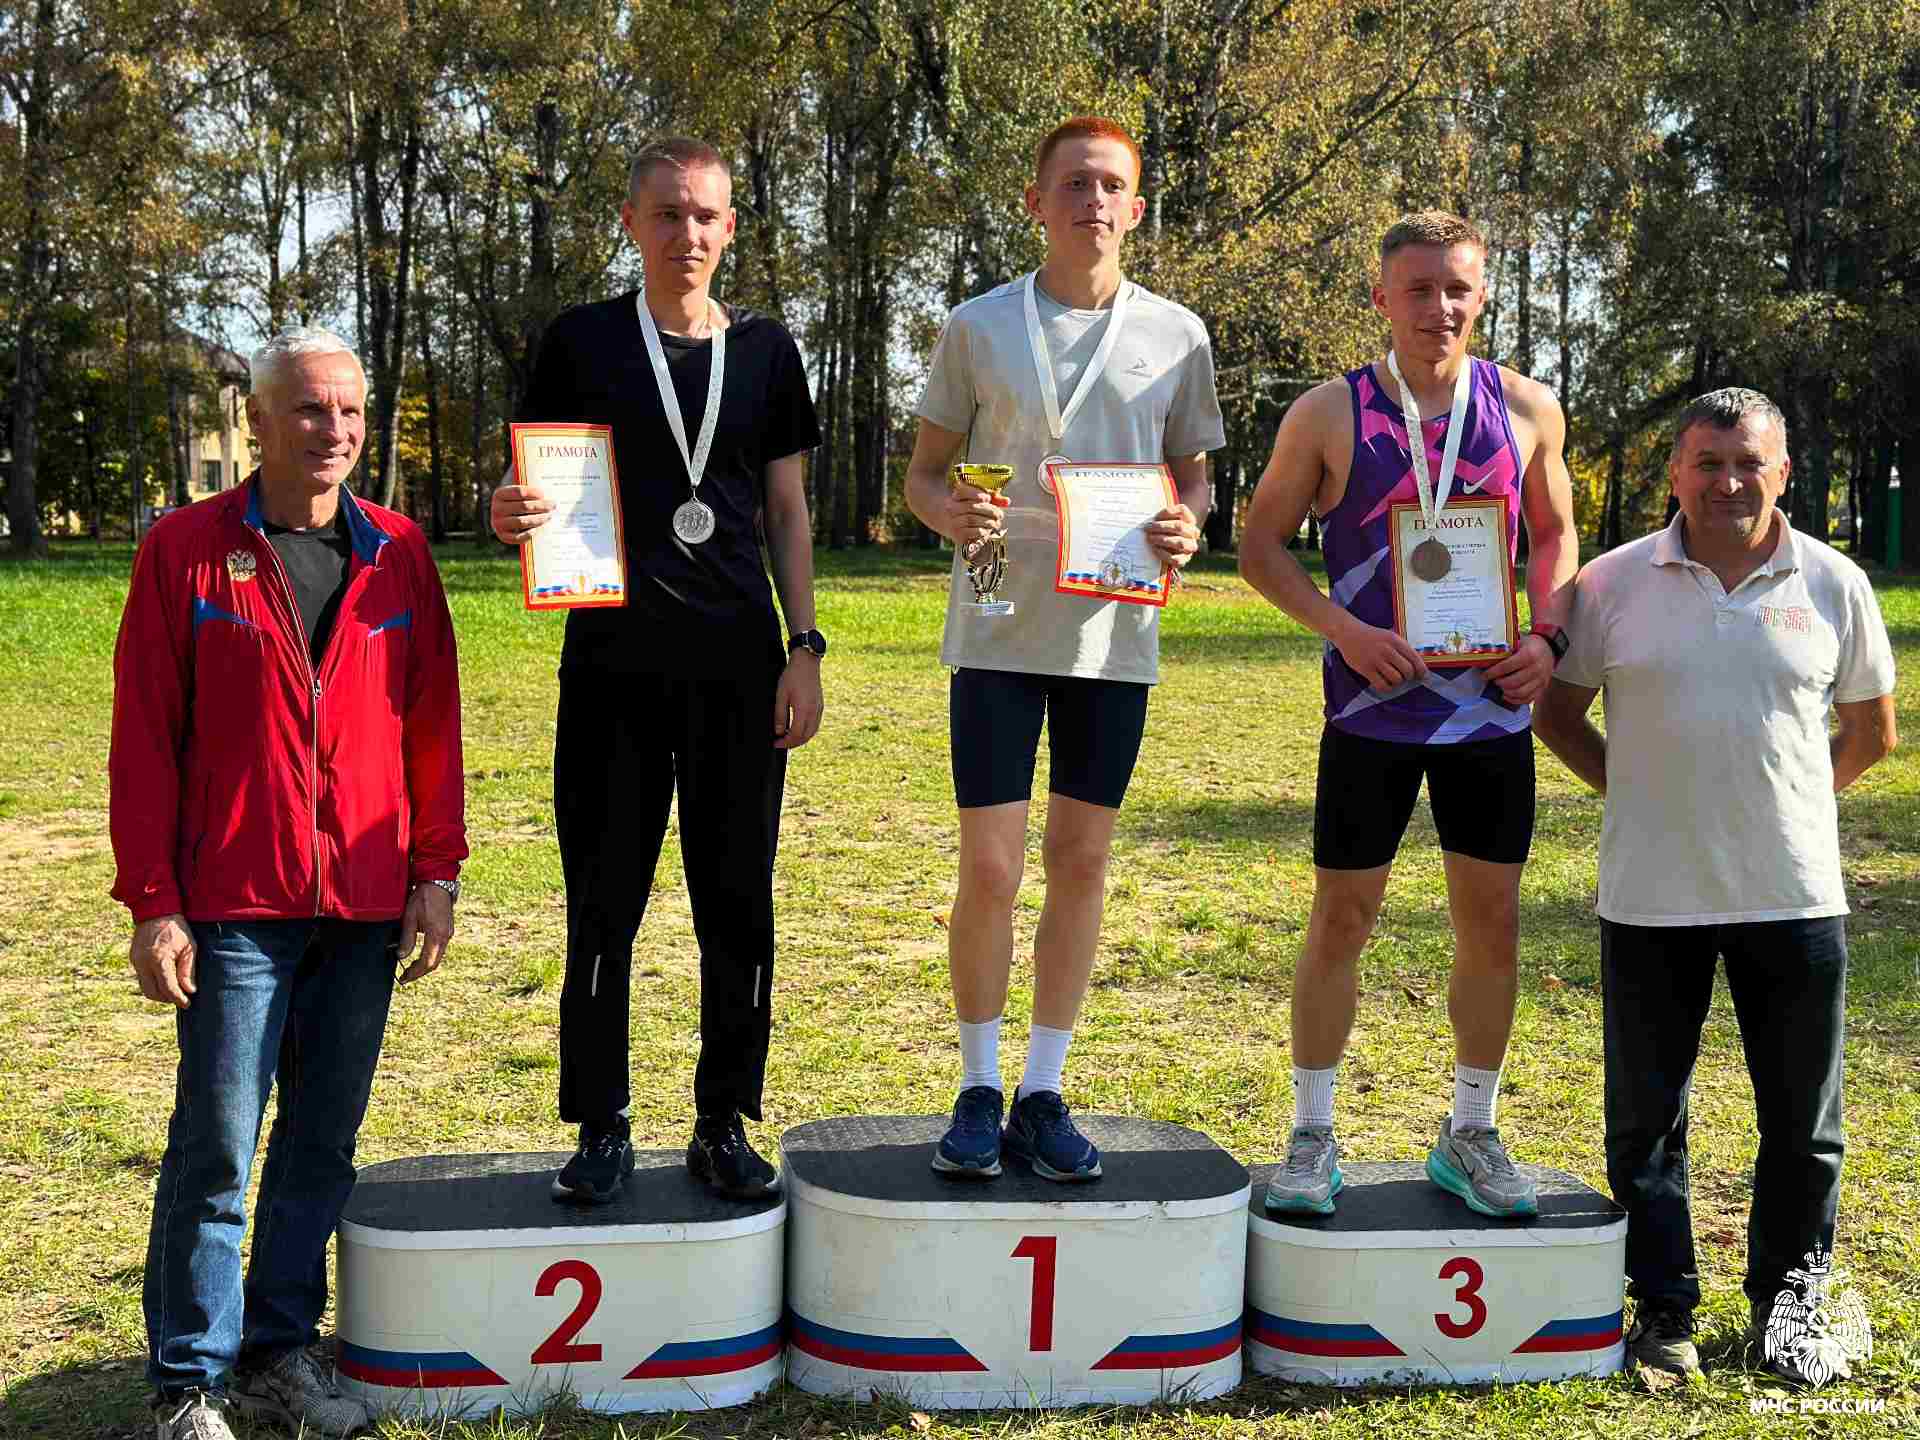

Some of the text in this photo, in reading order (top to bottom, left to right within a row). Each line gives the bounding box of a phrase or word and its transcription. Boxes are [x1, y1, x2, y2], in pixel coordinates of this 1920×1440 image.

[537, 445, 599, 458] ГРАМОТА
[1073, 471, 1145, 480] ГРАМОТА
[530, 1260, 604, 1364] 2
[1010, 1236, 1057, 1352] 1
[1434, 1256, 1486, 1340] 3
